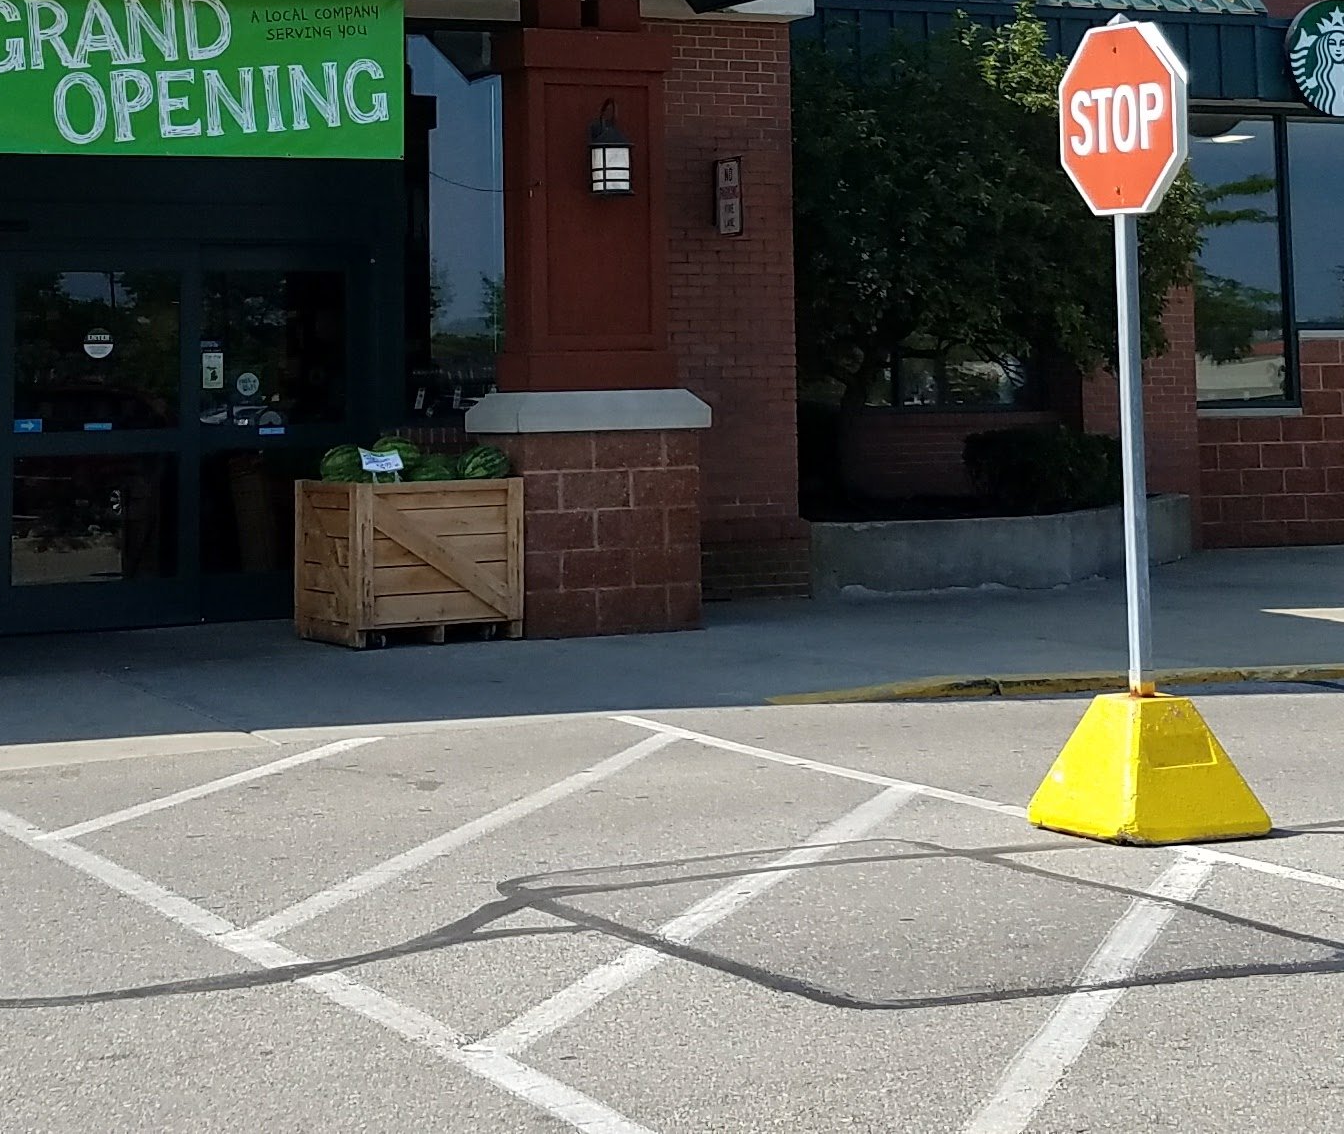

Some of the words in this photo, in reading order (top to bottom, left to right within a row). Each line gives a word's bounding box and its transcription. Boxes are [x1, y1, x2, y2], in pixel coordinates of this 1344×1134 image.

[250, 9, 260, 24] A
[265, 7, 309, 23] LOCAL
[314, 4, 380, 22] COMPANY
[265, 26, 333, 41] SERVING
[337, 24, 368, 39] YOU
[52, 58, 390, 145] OPENING
[1069, 81, 1165, 157] STOP
